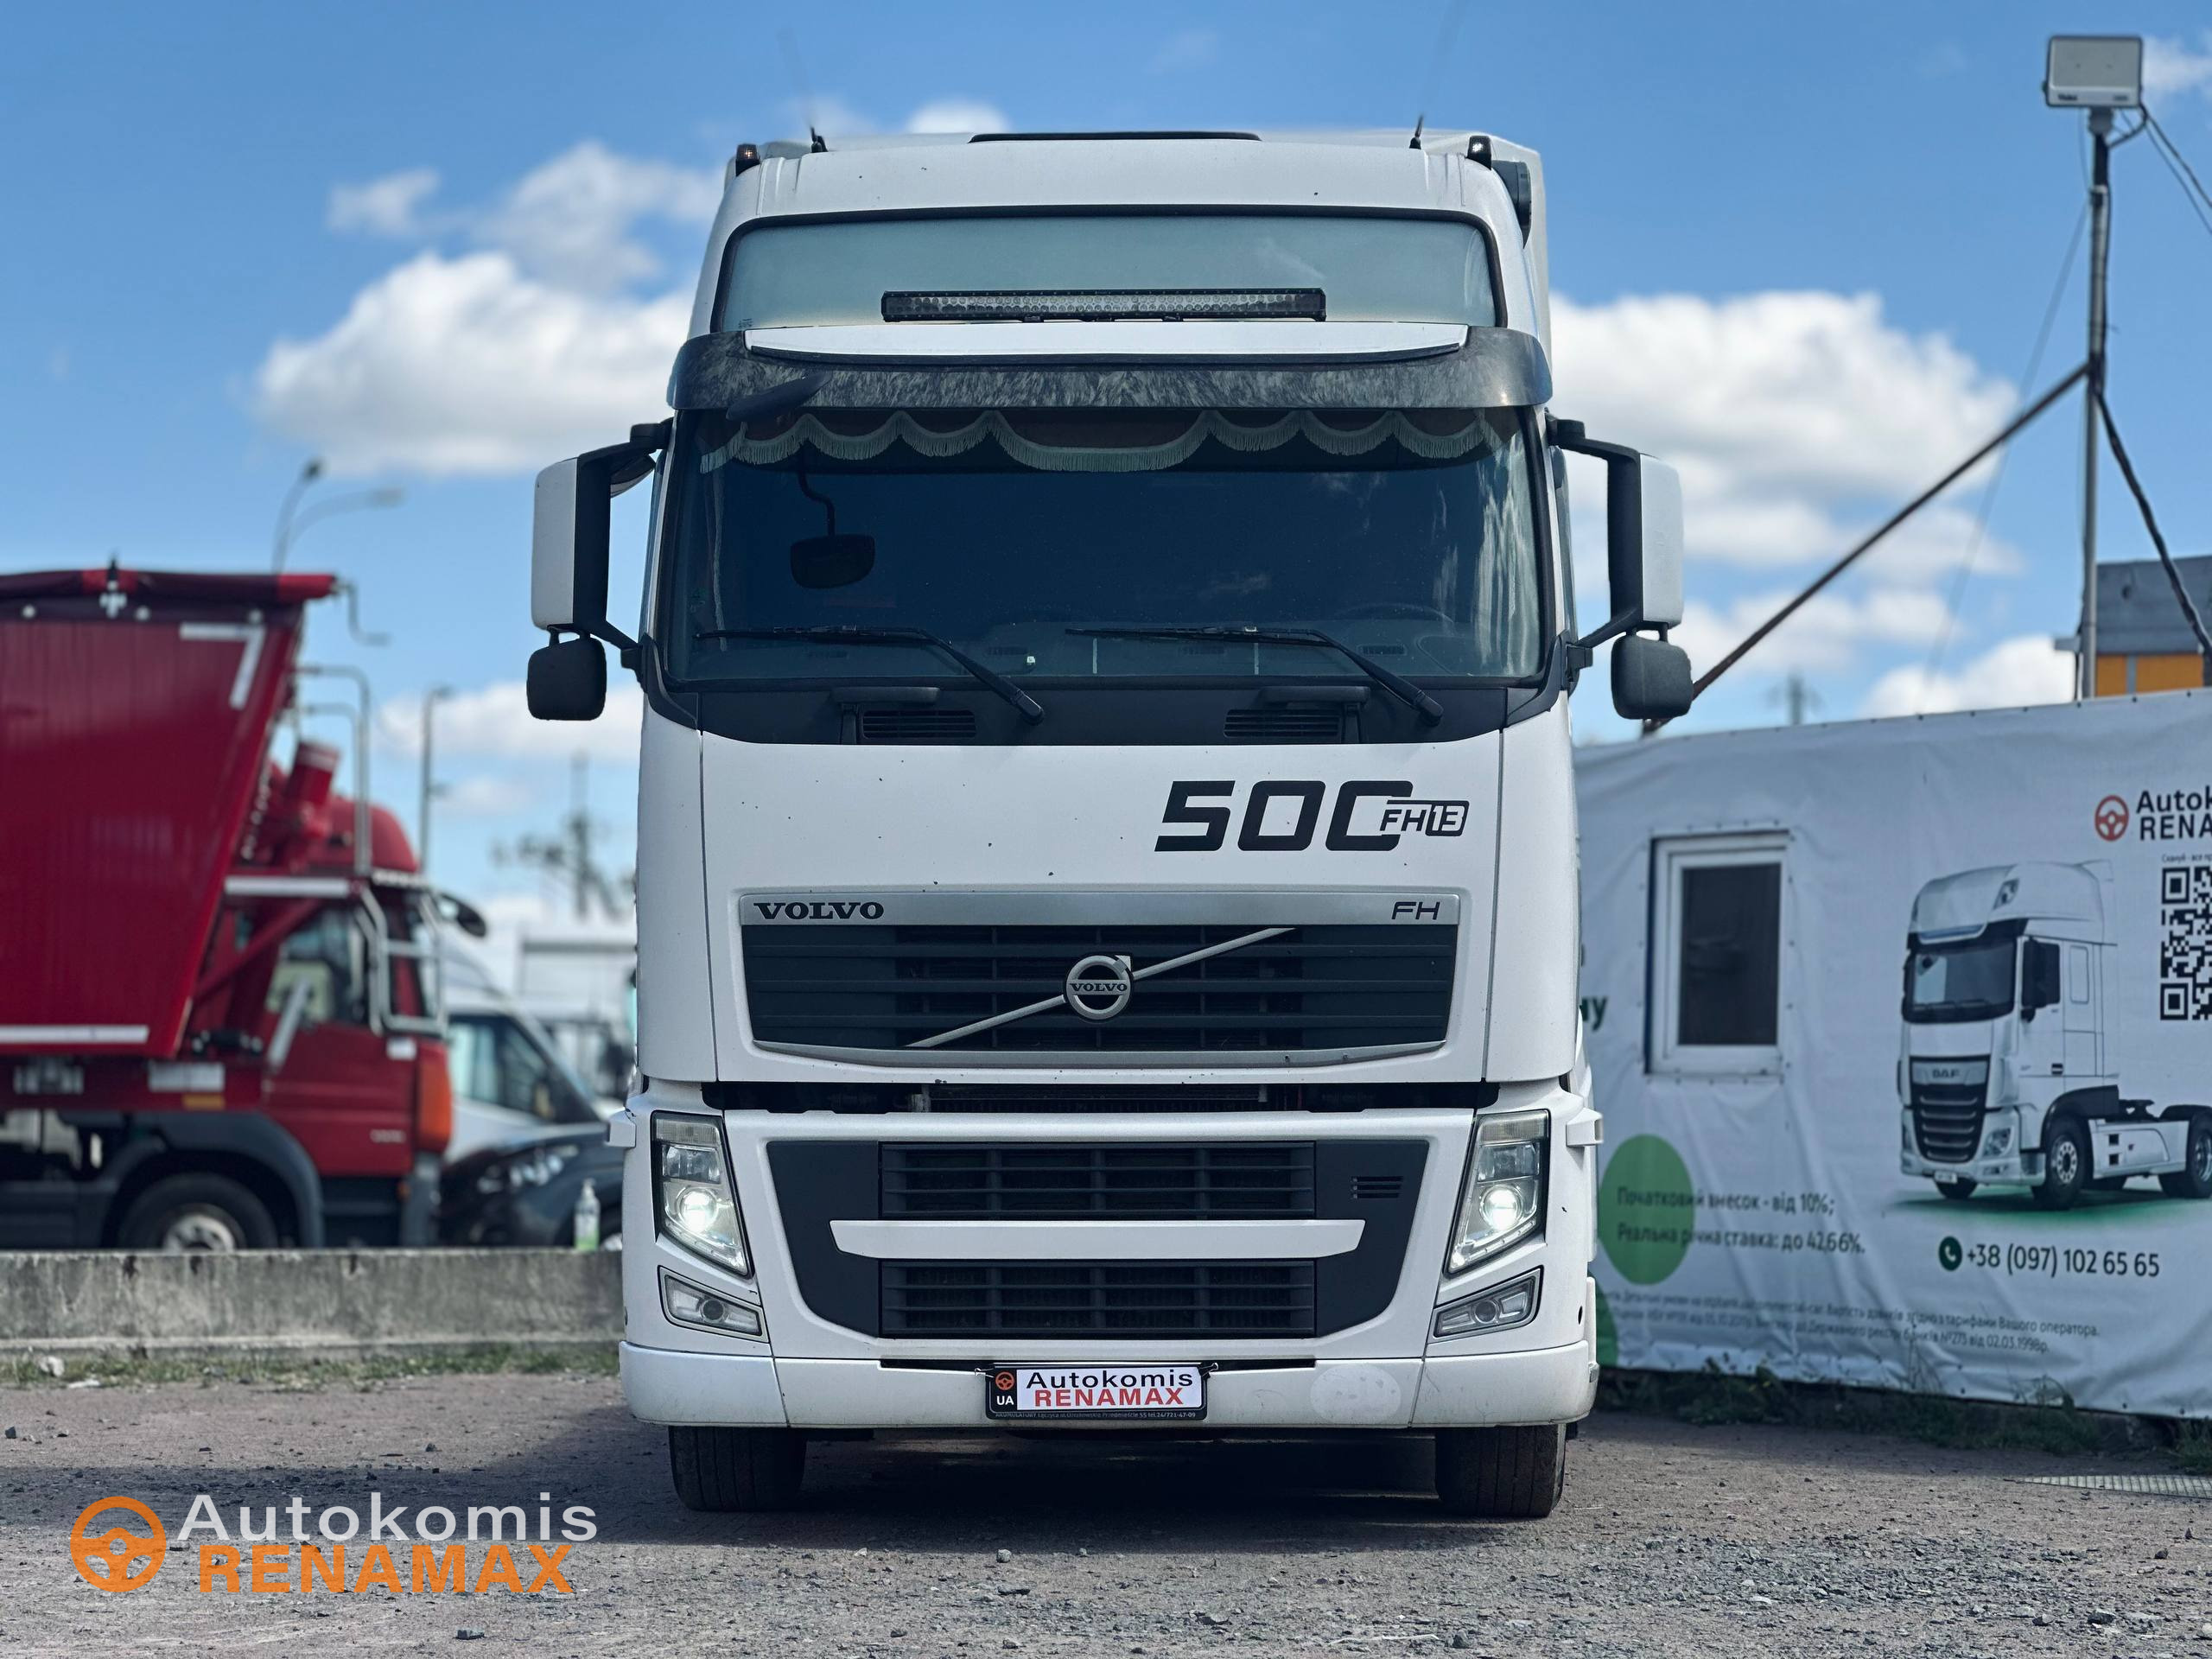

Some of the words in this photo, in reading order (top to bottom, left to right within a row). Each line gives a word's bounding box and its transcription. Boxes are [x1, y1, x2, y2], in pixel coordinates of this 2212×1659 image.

[1380, 800, 1468, 836] FH13
[2140, 813, 2212, 842] RENA
[753, 901, 884, 919] VOLVO
[1391, 901, 1440, 920] FH
[1070, 982, 1128, 992] VOLVO
[1772, 1192, 1796, 1215] від
[1800, 1193, 1834, 1216] 10%;
[1782, 1234, 1803, 1252] до
[1967, 1243, 2001, 1268] +38
[2007, 1243, 2058, 1279] (097)
[2063, 1249, 2097, 1274] 102
[2103, 1250, 2127, 1275] 65
[2133, 1252, 2160, 1278] 65
[1999, 1316, 2037, 1332] Вашого
[1026, 1370, 1193, 1389] Autokomis
[996, 1395, 1014, 1406] UA
[1034, 1388, 1184, 1407] RENAMAX
